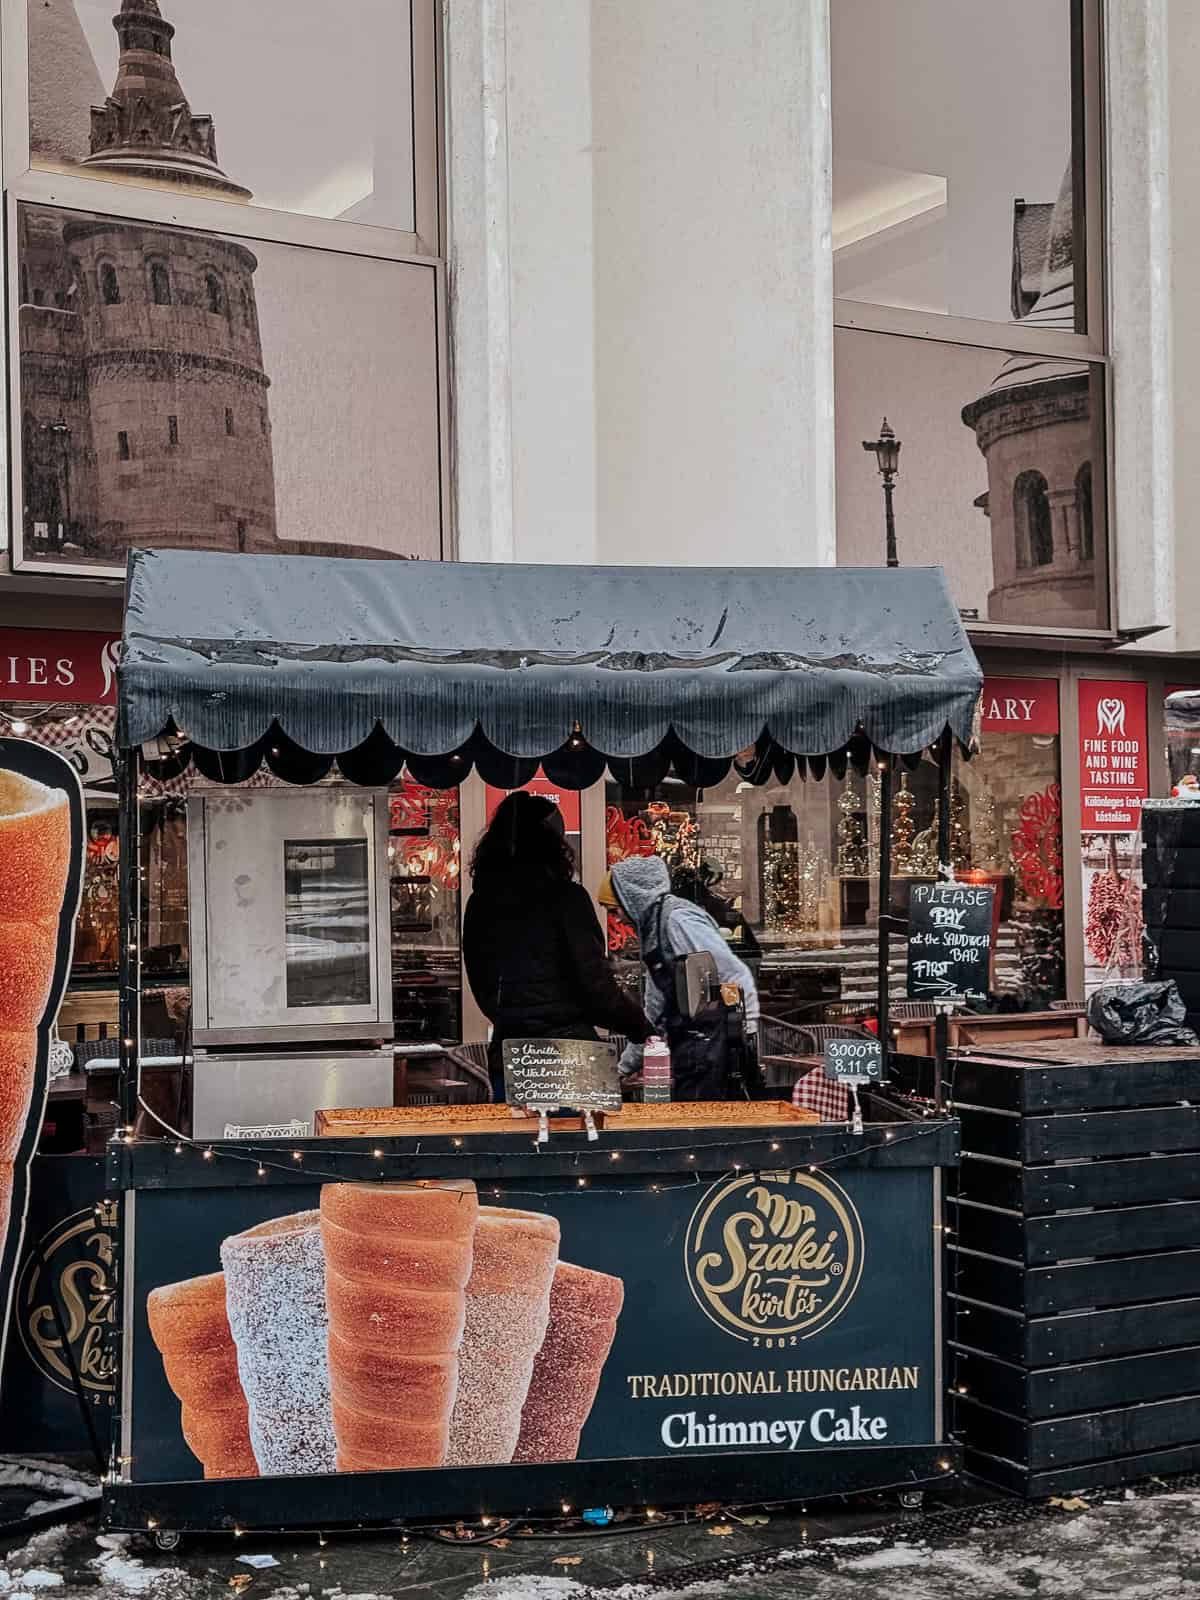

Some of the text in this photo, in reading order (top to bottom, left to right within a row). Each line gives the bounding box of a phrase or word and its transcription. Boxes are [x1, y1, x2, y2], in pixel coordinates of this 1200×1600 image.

[0, 656, 75, 686] IES
[982, 697, 1036, 720] ARY
[1084, 739, 1139, 754] FINE FOOD
[1086, 755, 1138, 769] AND WINE
[1090, 771, 1135, 785] TASTING
[915, 886, 989, 906] PLEASE
[929, 906, 967, 926] PAY
[910, 933, 923, 945] at
[923, 933, 940, 945] the
[949, 948, 980, 963] BAR
[912, 960, 954, 978] FIRST
[522, 1043, 560, 1055] Vanilla
[520, 1055, 583, 1066] Cinnamon
[835, 1058, 861, 1073] 8.11
[521, 1067, 570, 1078] Walnut
[522, 1079, 576, 1090] Coconut
[696, 1212, 840, 1294] Szaki
[741, 1271, 831, 1324] kürtös
[752, 1335, 798, 1349] 2002
[80, 1325, 114, 1380] kü
[627, 1366, 920, 1399] TRADITIONAL HUNGARIAN
[660, 1404, 889, 1451] Chimney Cake
